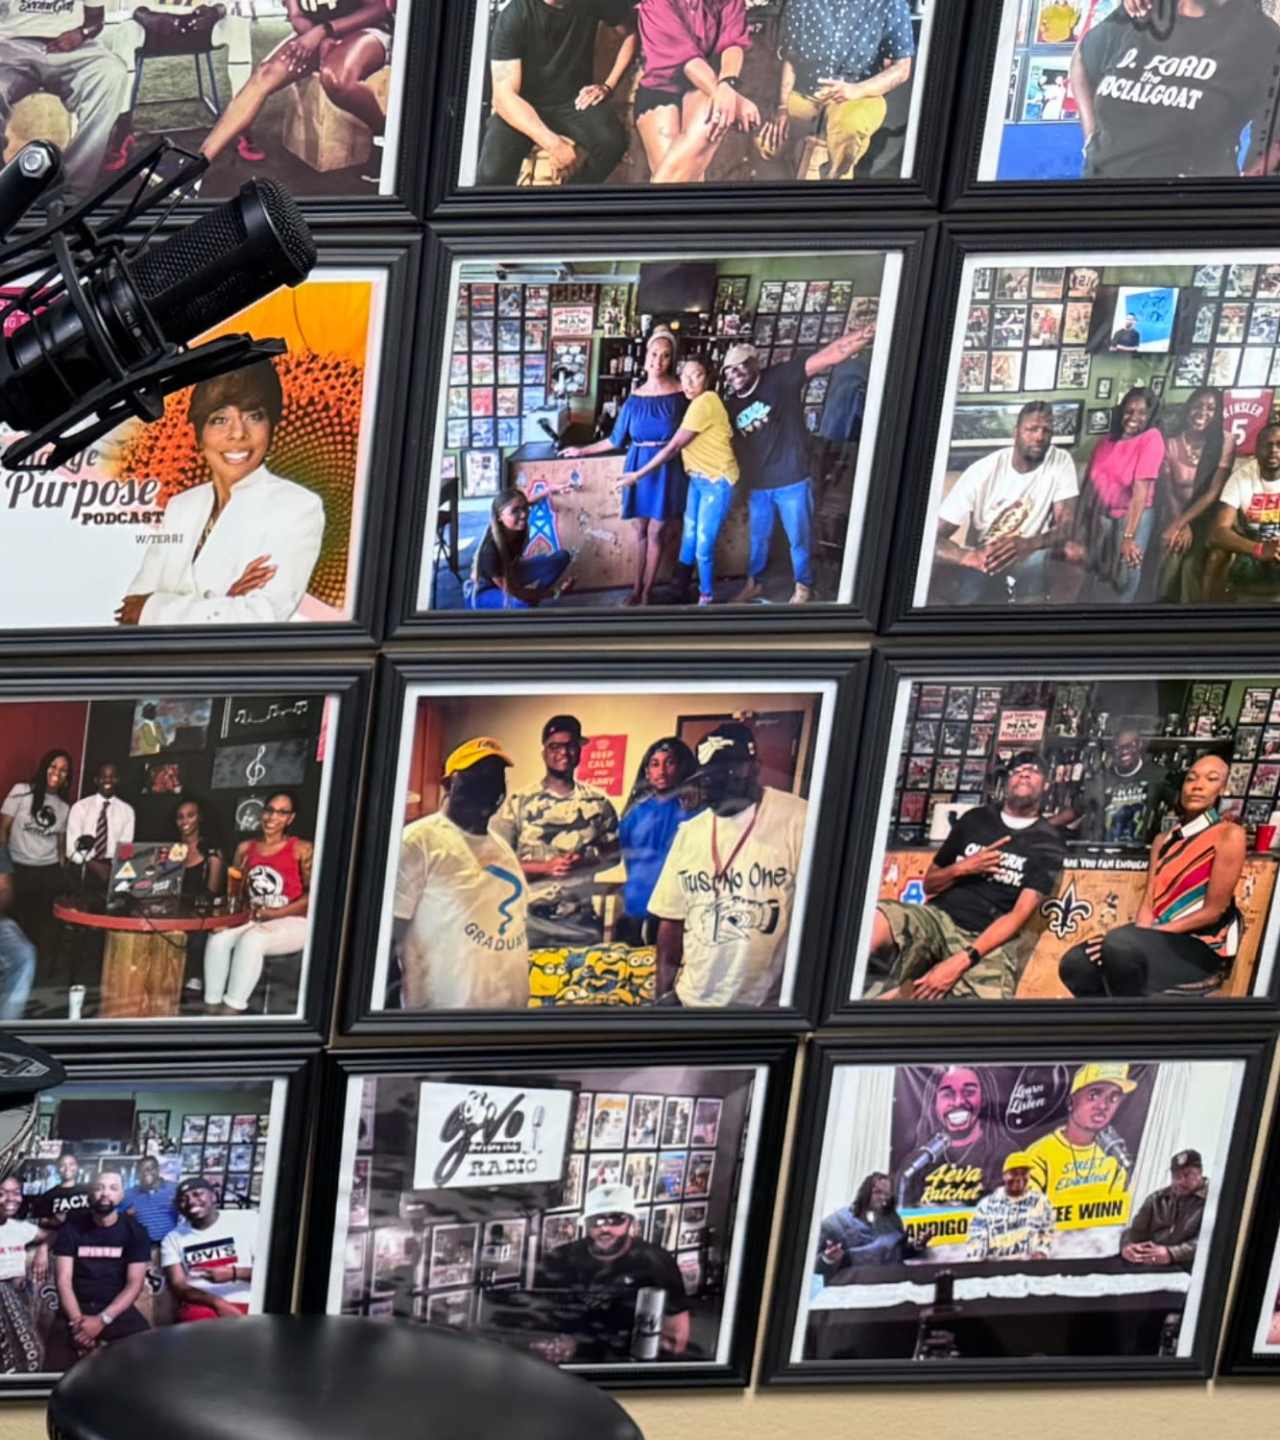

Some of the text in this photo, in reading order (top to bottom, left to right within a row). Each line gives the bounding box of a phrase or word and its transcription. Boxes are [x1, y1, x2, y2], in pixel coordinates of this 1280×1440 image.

[1144, 55, 1217, 80] FORD
[1231, 417, 1249, 446] 5
[5, 469, 160, 521] Purpose
[80, 510, 166, 526] PODCAST
[135, 533, 185, 545] W/TERRI
[588, 759, 615, 768] CALM
[590, 751, 614, 759] KEEP
[749, 861, 788, 889] One
[468, 1158, 538, 1177] RADIO
[925, 1163, 984, 1184] 4eva
[920, 1182, 984, 1204] Ratchet
[1078, 1199, 1123, 1222] WINN
